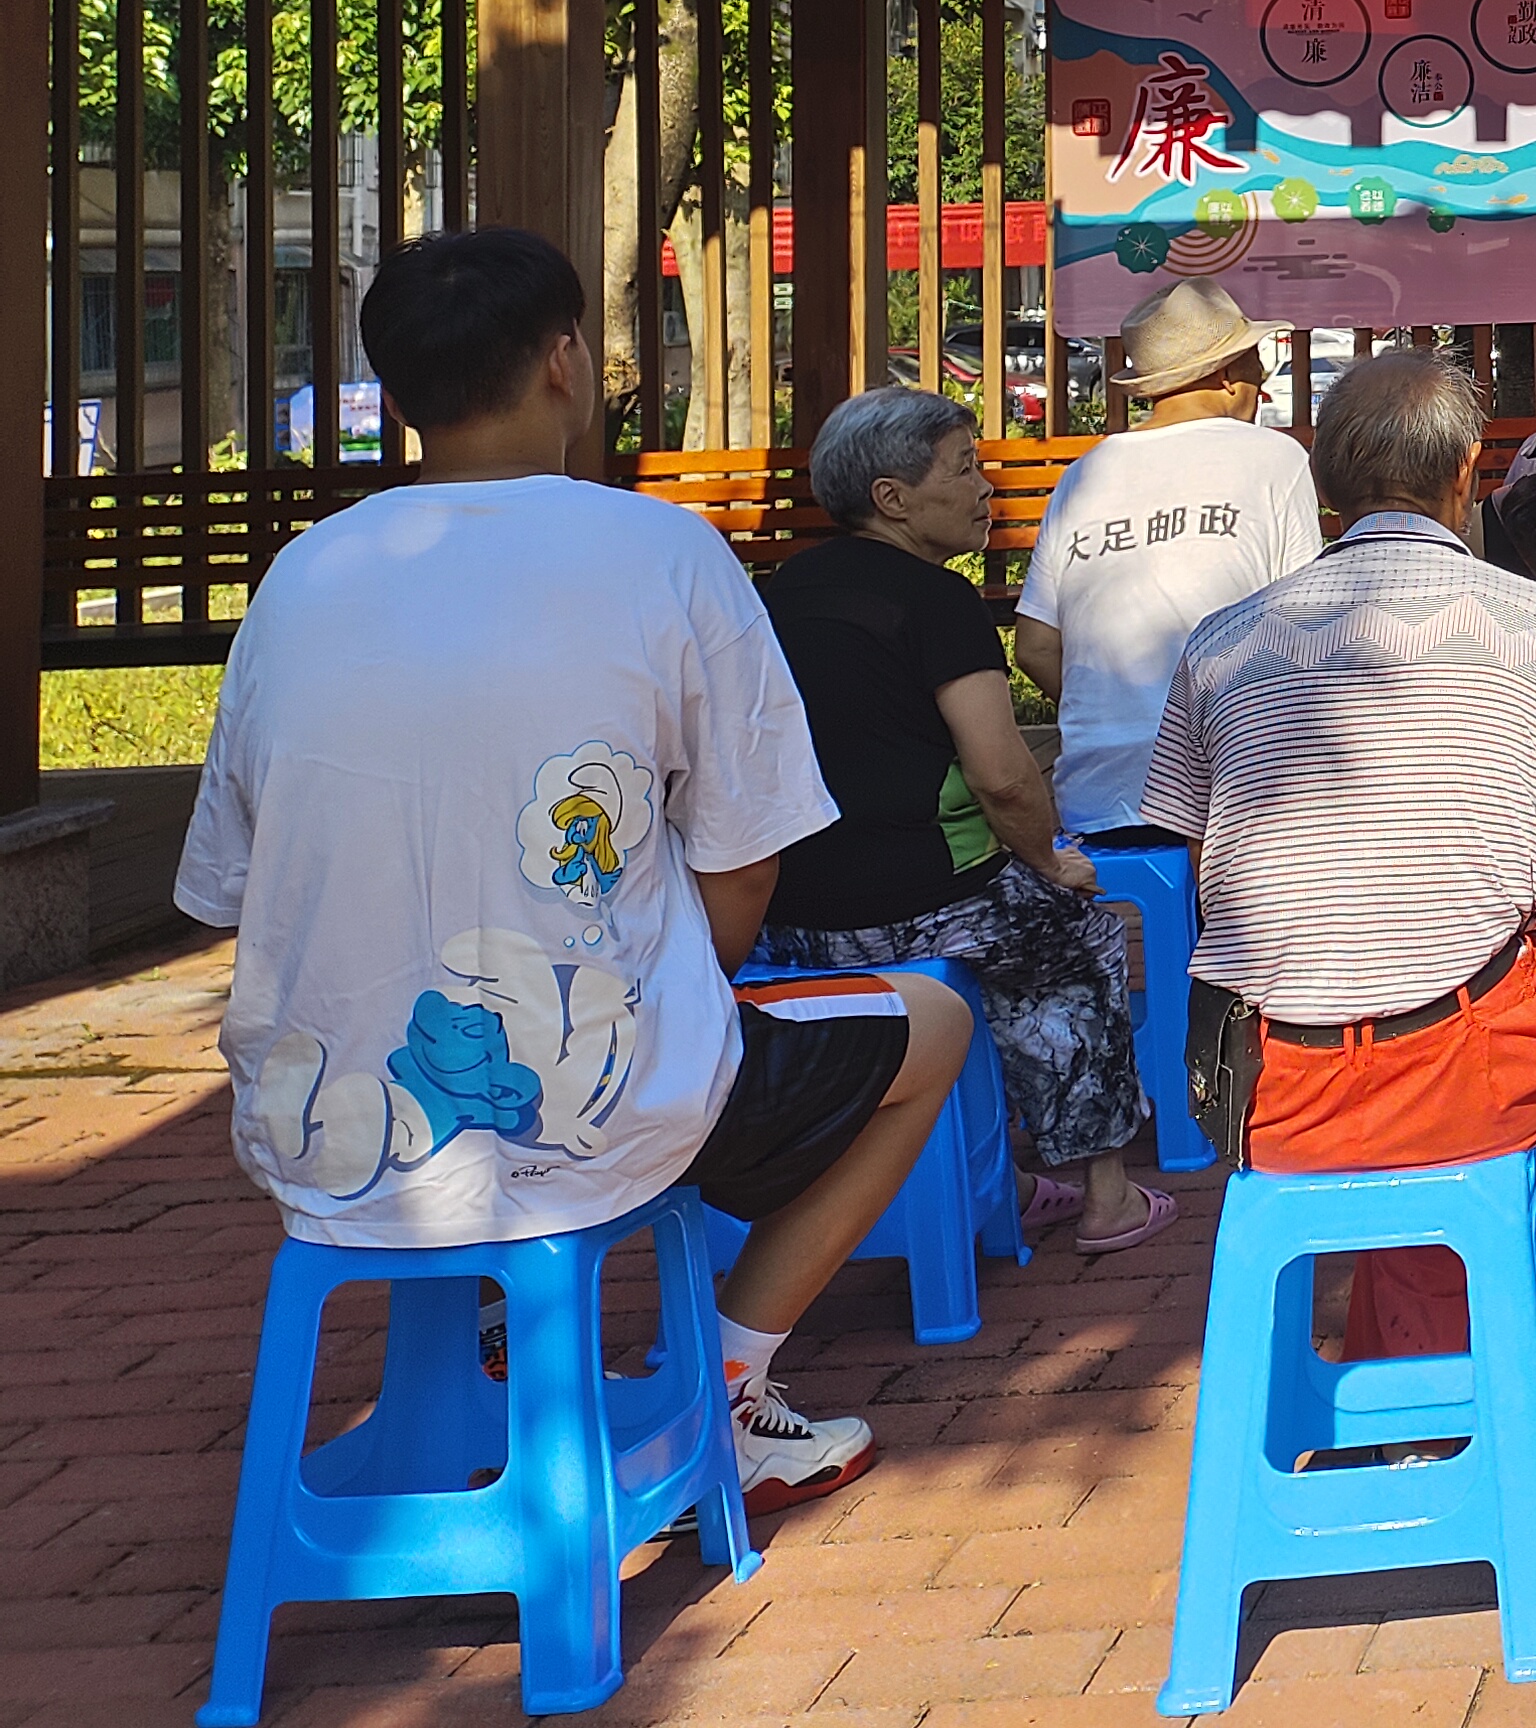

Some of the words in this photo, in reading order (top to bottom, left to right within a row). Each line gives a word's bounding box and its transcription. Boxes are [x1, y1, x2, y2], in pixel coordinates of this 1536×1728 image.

[1410, 59, 1432, 104] 廉洁
[1110, 55, 1247, 182] 廉
[1067, 502, 1241, 568] 大足邮政
